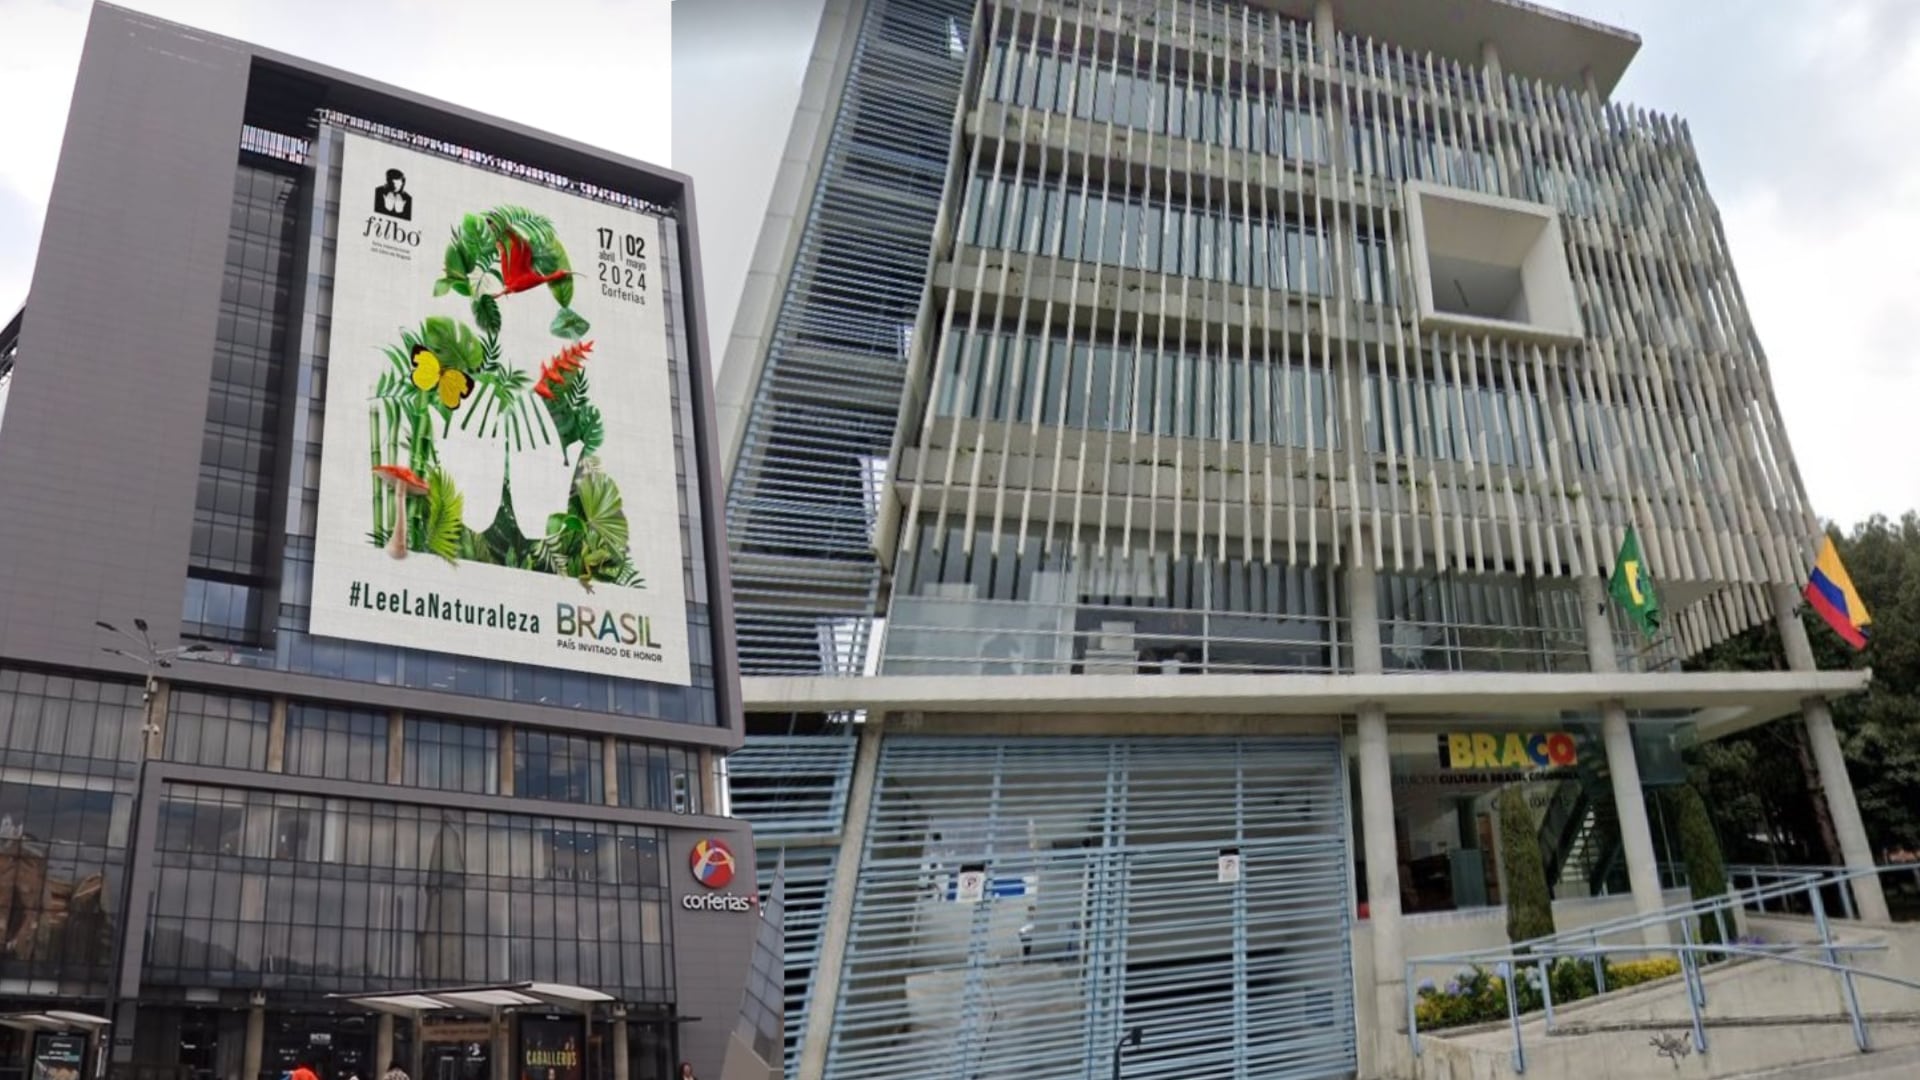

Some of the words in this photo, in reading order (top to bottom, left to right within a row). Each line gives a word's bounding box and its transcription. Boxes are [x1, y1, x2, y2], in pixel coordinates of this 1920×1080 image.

[596, 227, 613, 250] 17
[625, 234, 645, 259] 02
[598, 250, 615, 262] abril
[626, 258, 647, 272] mayo
[598, 262, 646, 291] 2024
[601, 283, 645, 305] Corferias
[349, 581, 540, 634] #LeeLaNaturaleza
[557, 603, 661, 649] BRASIL
[557, 638, 576, 651] PAÍS
[578, 642, 618, 657] INVITADO
[619, 648, 631, 659] DE
[633, 650, 662, 662] HONOR
[682, 891, 750, 911] corferias
